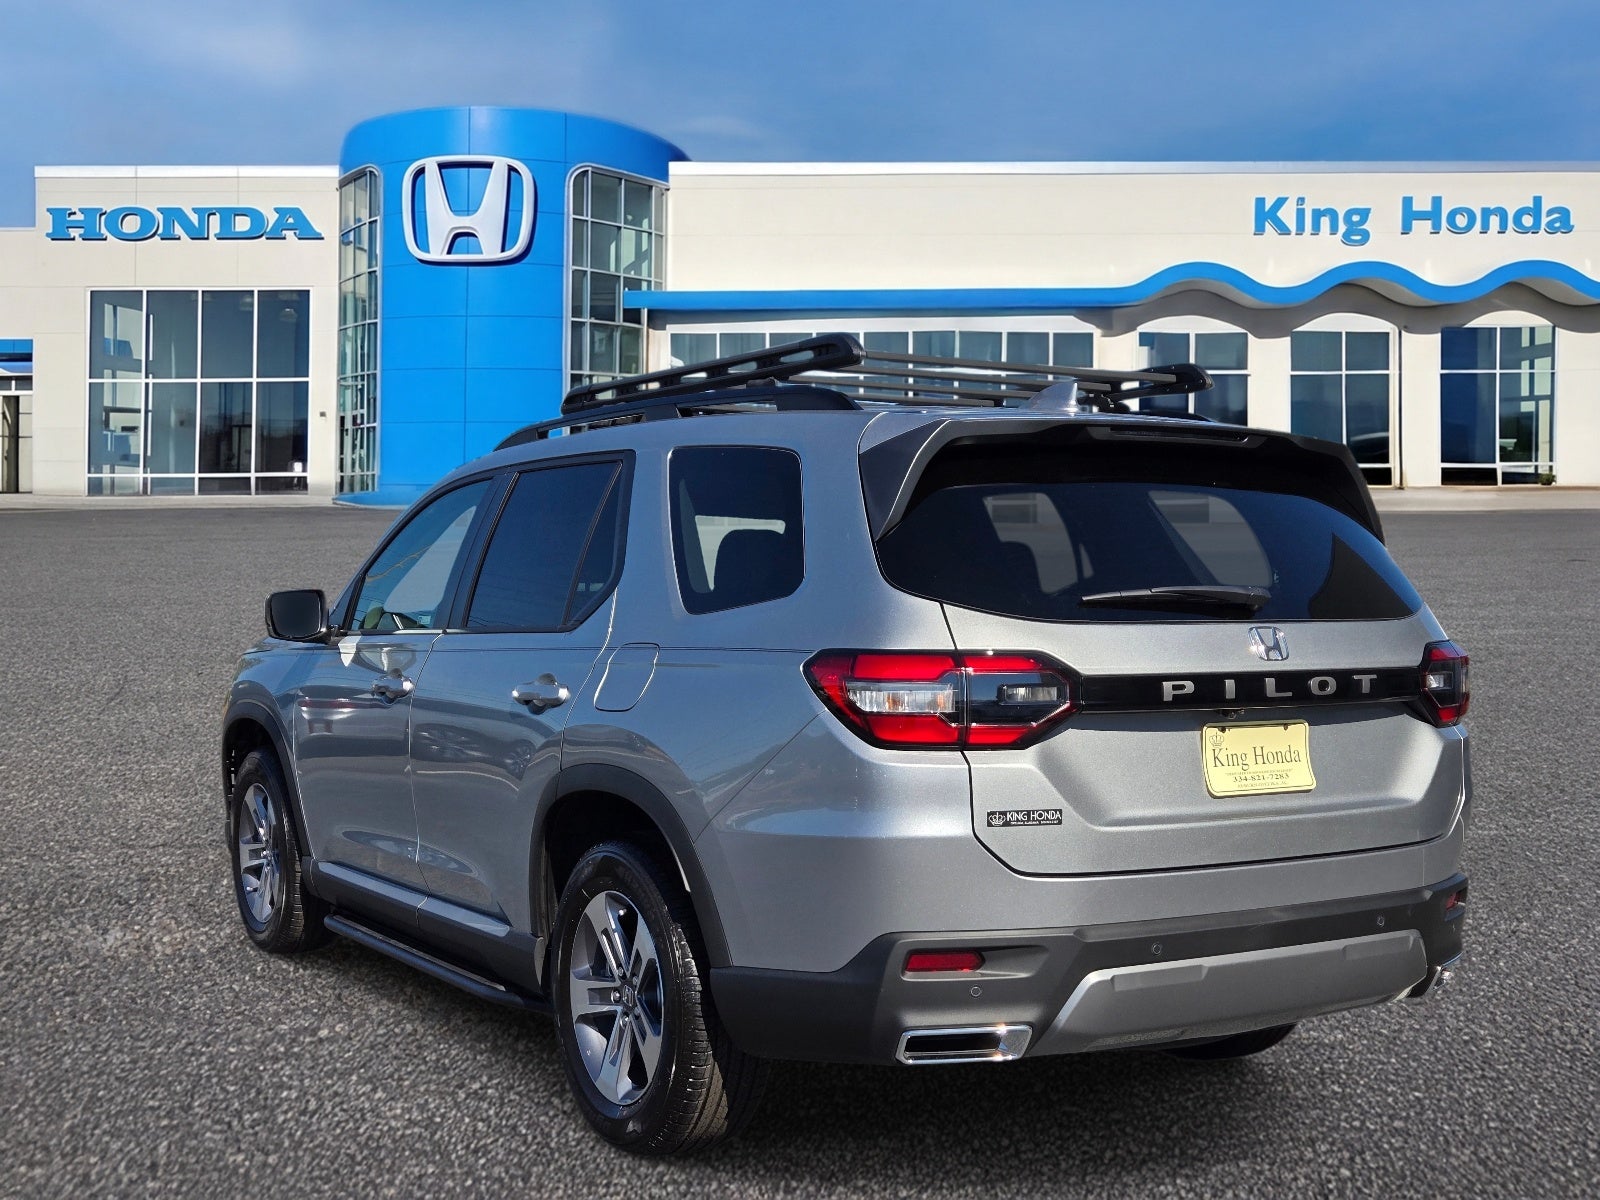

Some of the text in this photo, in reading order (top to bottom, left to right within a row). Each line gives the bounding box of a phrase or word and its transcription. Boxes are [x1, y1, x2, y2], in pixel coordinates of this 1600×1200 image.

[45, 206, 324, 242] HONDA
[1253, 194, 1575, 247] King Honda
[1162, 674, 1377, 702] PILOT
[1212, 744, 1301, 771] King Honda
[1232, 772, 1290, 783] 334-821-7283
[1006, 810, 1062, 822] KING HONDA
